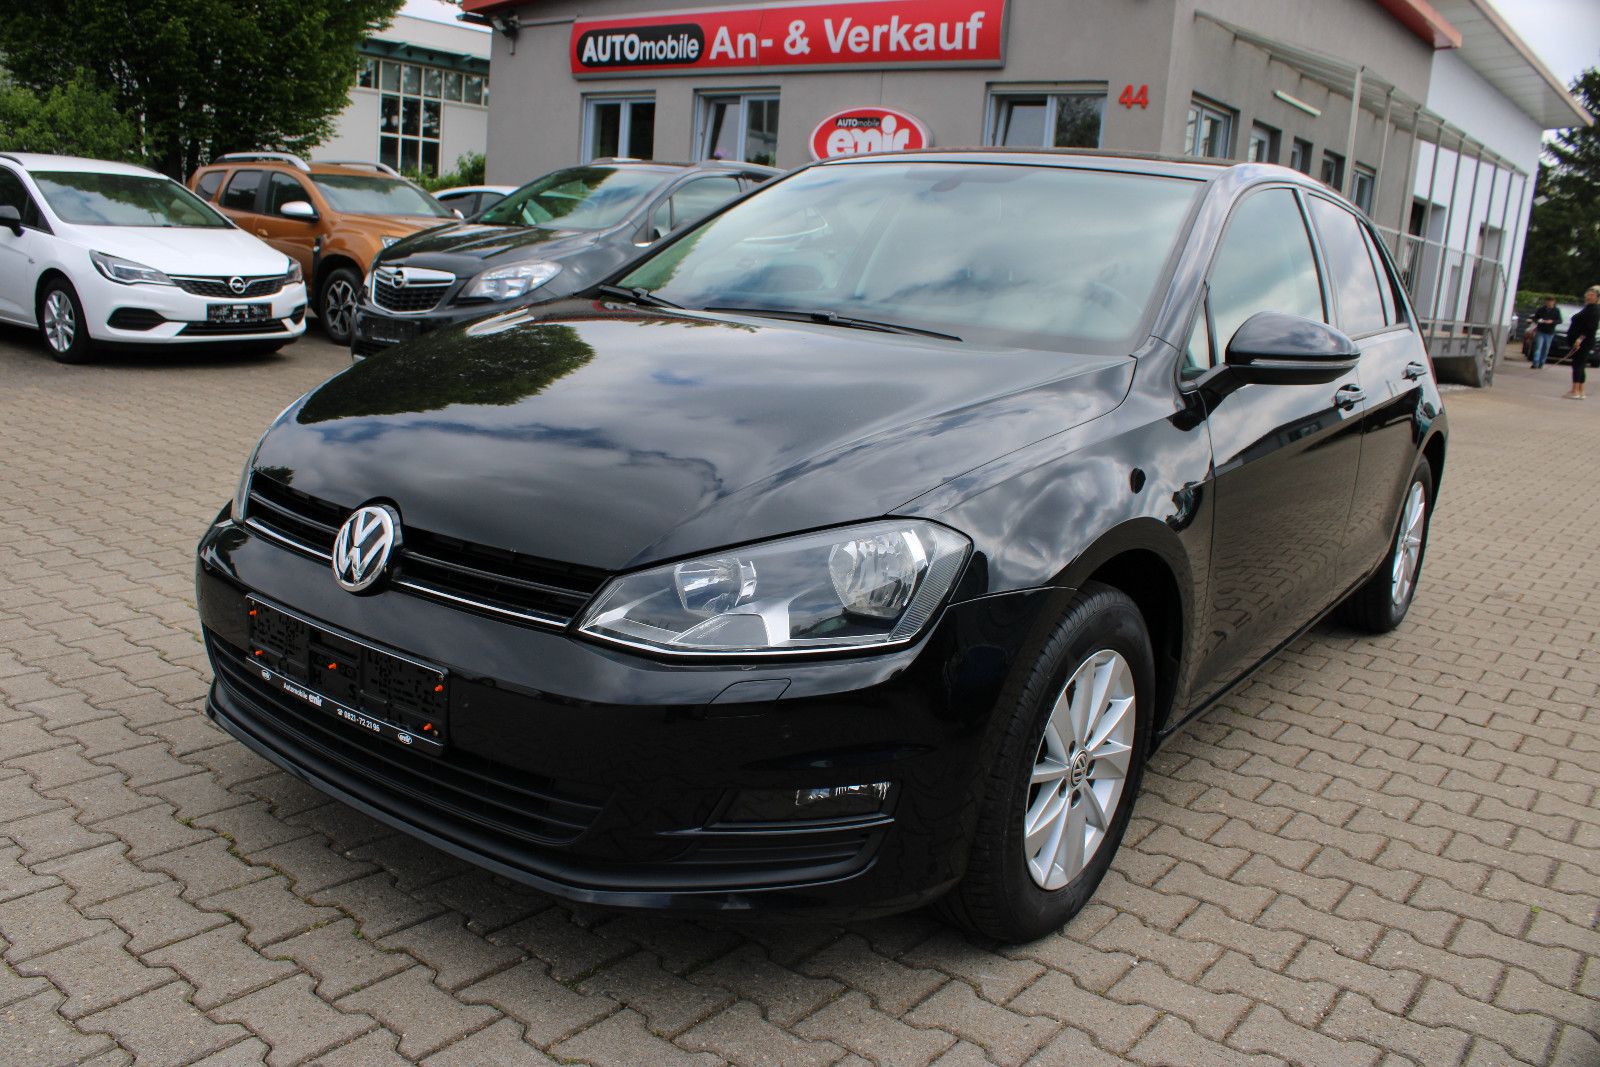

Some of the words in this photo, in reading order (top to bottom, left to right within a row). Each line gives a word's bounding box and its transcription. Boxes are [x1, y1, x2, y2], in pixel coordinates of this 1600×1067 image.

[581, 33, 700, 63] AUTOmobile
[709, 26, 774, 60] An-
[784, 19, 811, 55] &
[824, 11, 986, 54] Verkauf
[1118, 83, 1149, 110] 44
[837, 118, 880, 128] AUTOmobile
